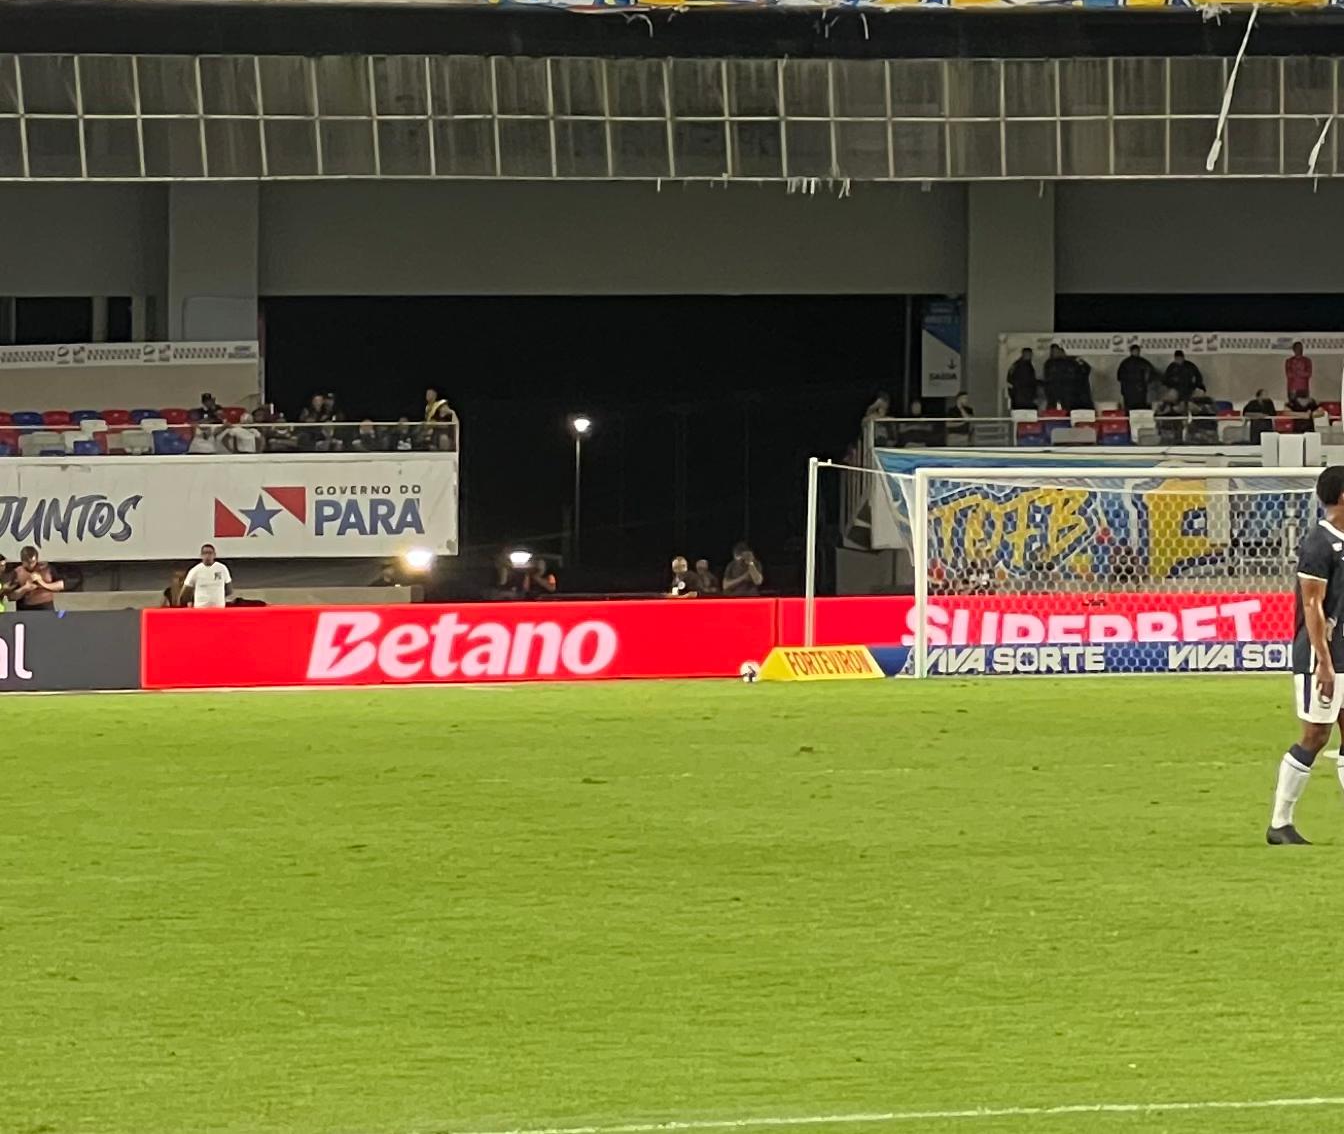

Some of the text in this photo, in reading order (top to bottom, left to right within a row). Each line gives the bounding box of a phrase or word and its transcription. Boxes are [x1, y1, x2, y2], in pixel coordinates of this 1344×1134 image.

[315, 484, 421, 495] GOVERNO DO
[307, 611, 619, 680] Betano
[1168, 644, 1236, 670] VIVA
[993, 646, 1106, 672] SORTE
